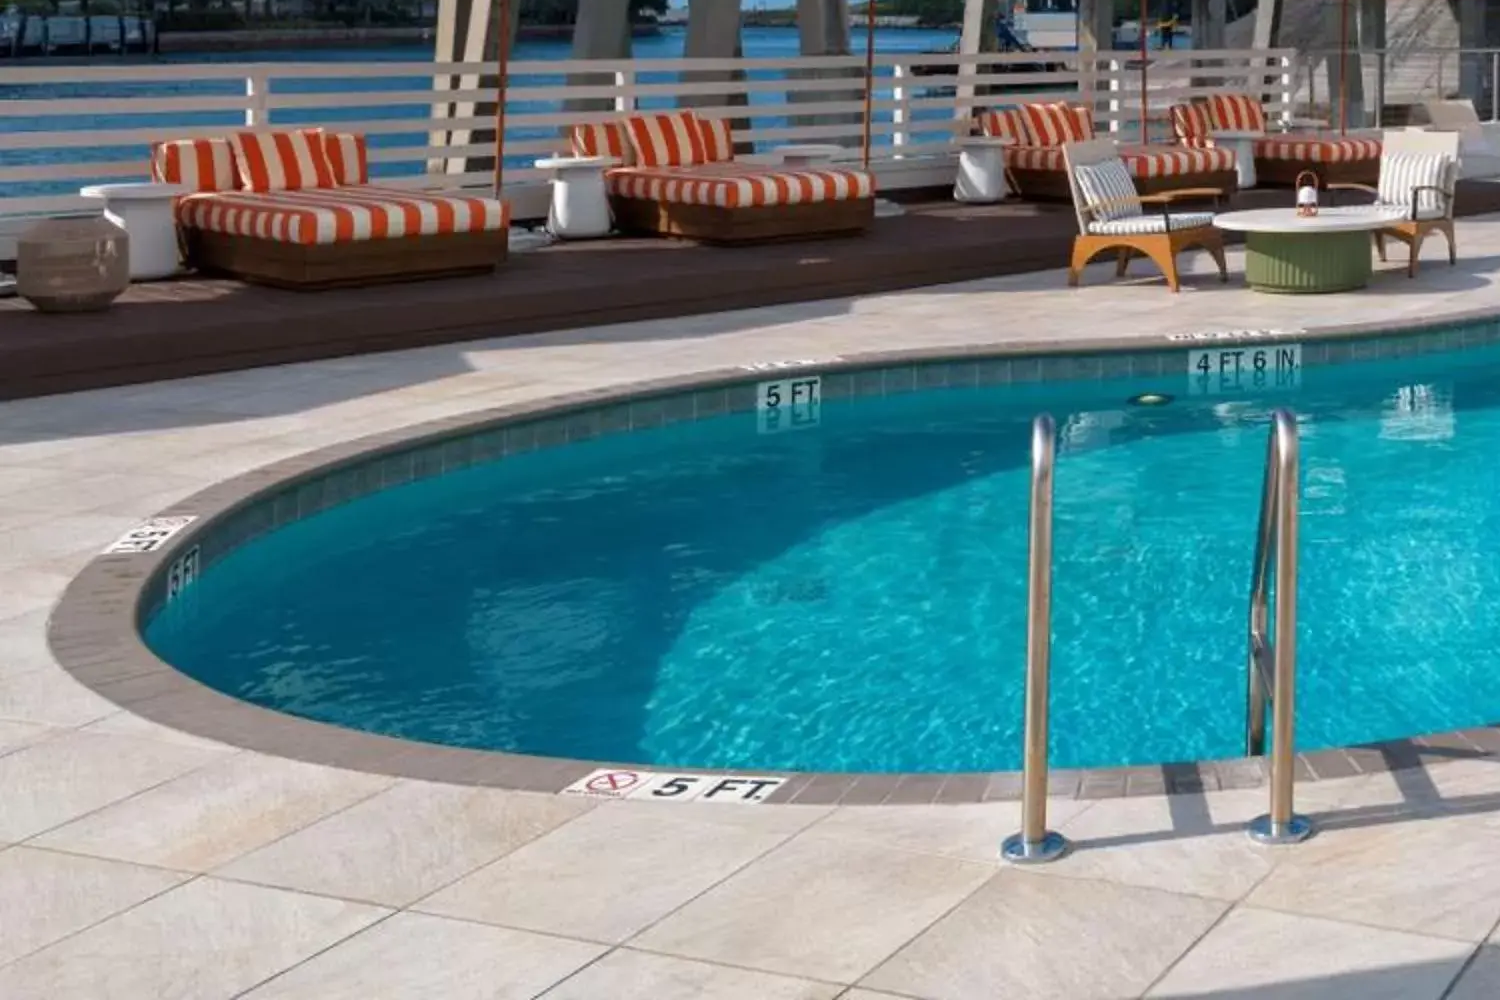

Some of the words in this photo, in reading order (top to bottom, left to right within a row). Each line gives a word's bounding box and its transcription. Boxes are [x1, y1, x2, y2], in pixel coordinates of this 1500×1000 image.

[1197, 353, 1211, 373] 4
[1253, 351, 1267, 371] 6
[767, 385, 781, 407] 5
[652, 777, 699, 797] 5
[704, 779, 779, 800] FT.
